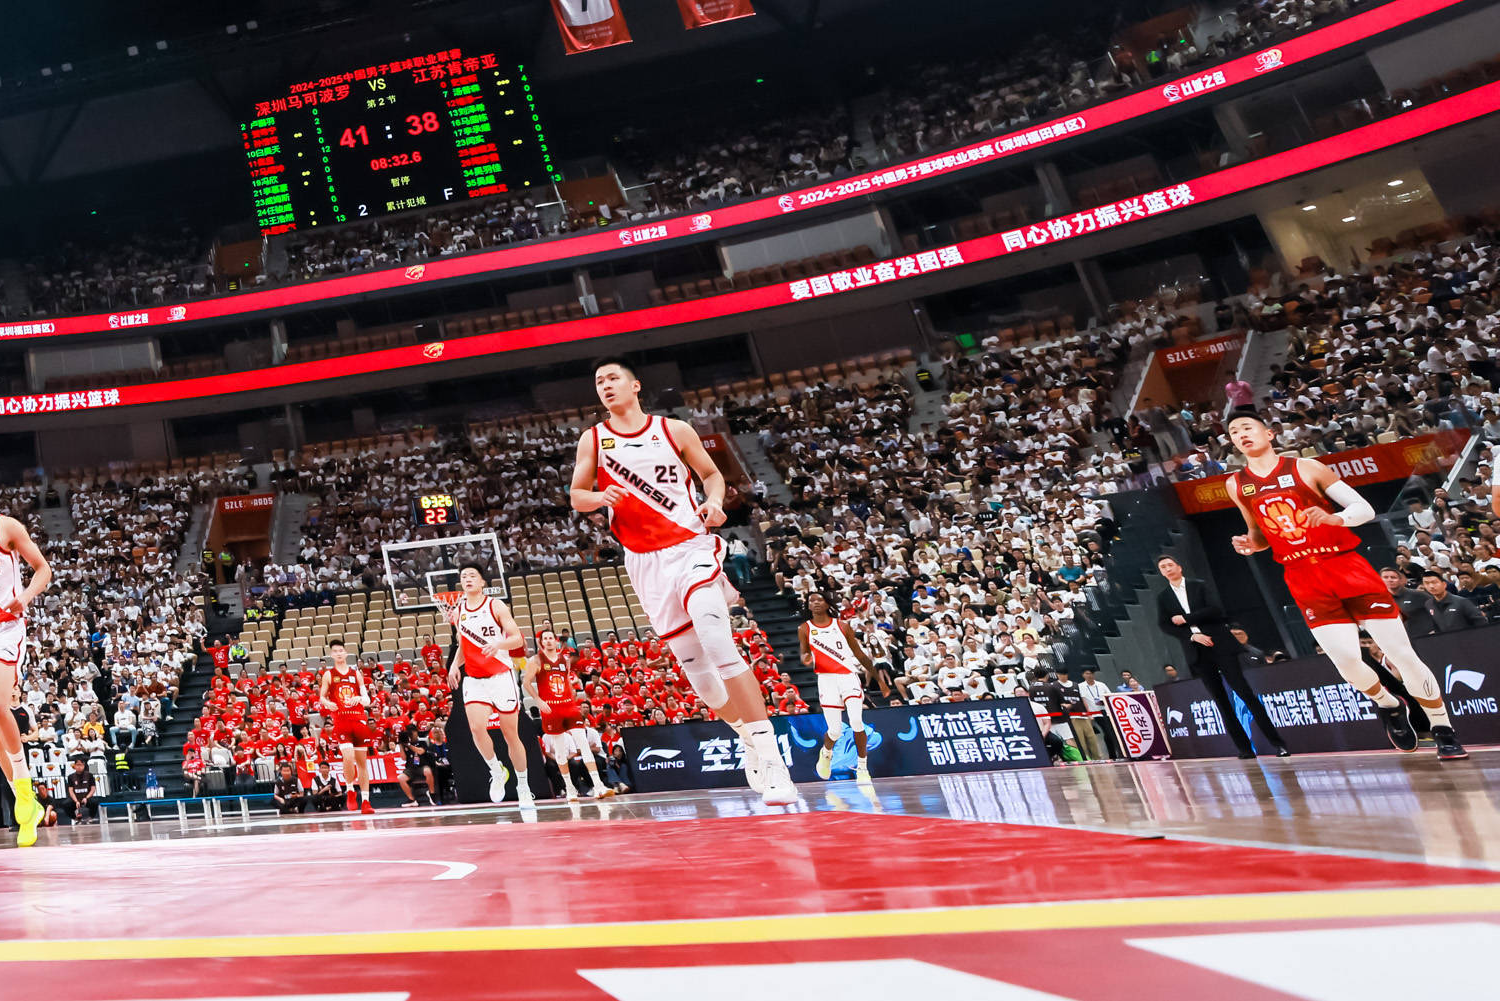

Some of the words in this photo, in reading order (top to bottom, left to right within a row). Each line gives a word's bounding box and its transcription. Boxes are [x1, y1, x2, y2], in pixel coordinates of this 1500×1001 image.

[255, 84, 350, 117] 深圳马可波罗
[368, 78, 387, 92] VS
[412, 53, 499, 84] 江苏肯帝亚
[339, 125, 369, 148] 41
[405, 112, 440, 136] 38
[370, 151, 422, 171] 08:32.6
[390, 175, 411, 188] 暂停
[358, 204, 368, 216] 2
[386, 196, 427, 212] 累计犯规
[443, 187, 454, 200] F
[789, 246, 965, 301] 爱国敬业奋发图强
[1001, 184, 1195, 252] 同心协力振兴篮球
[604, 454, 678, 512] JIANGSU
[654, 465, 678, 484] 25
[425, 508, 448, 525] 22
[1277, 514, 1296, 533] 3
[481, 626, 496, 637] 26
[836, 641, 843, 650] 0
[1262, 687, 1318, 728] 核芯聚能
[1451, 697, 1498, 716] LI-NING
[918, 708, 1025, 739] 核芯聚能
[1129, 703, 1152, 741] 百岁山
[1169, 726, 1190, 738] LI-NING
[926, 735, 1037, 766] 制霸领空
[638, 760, 685, 771] LI-NING
